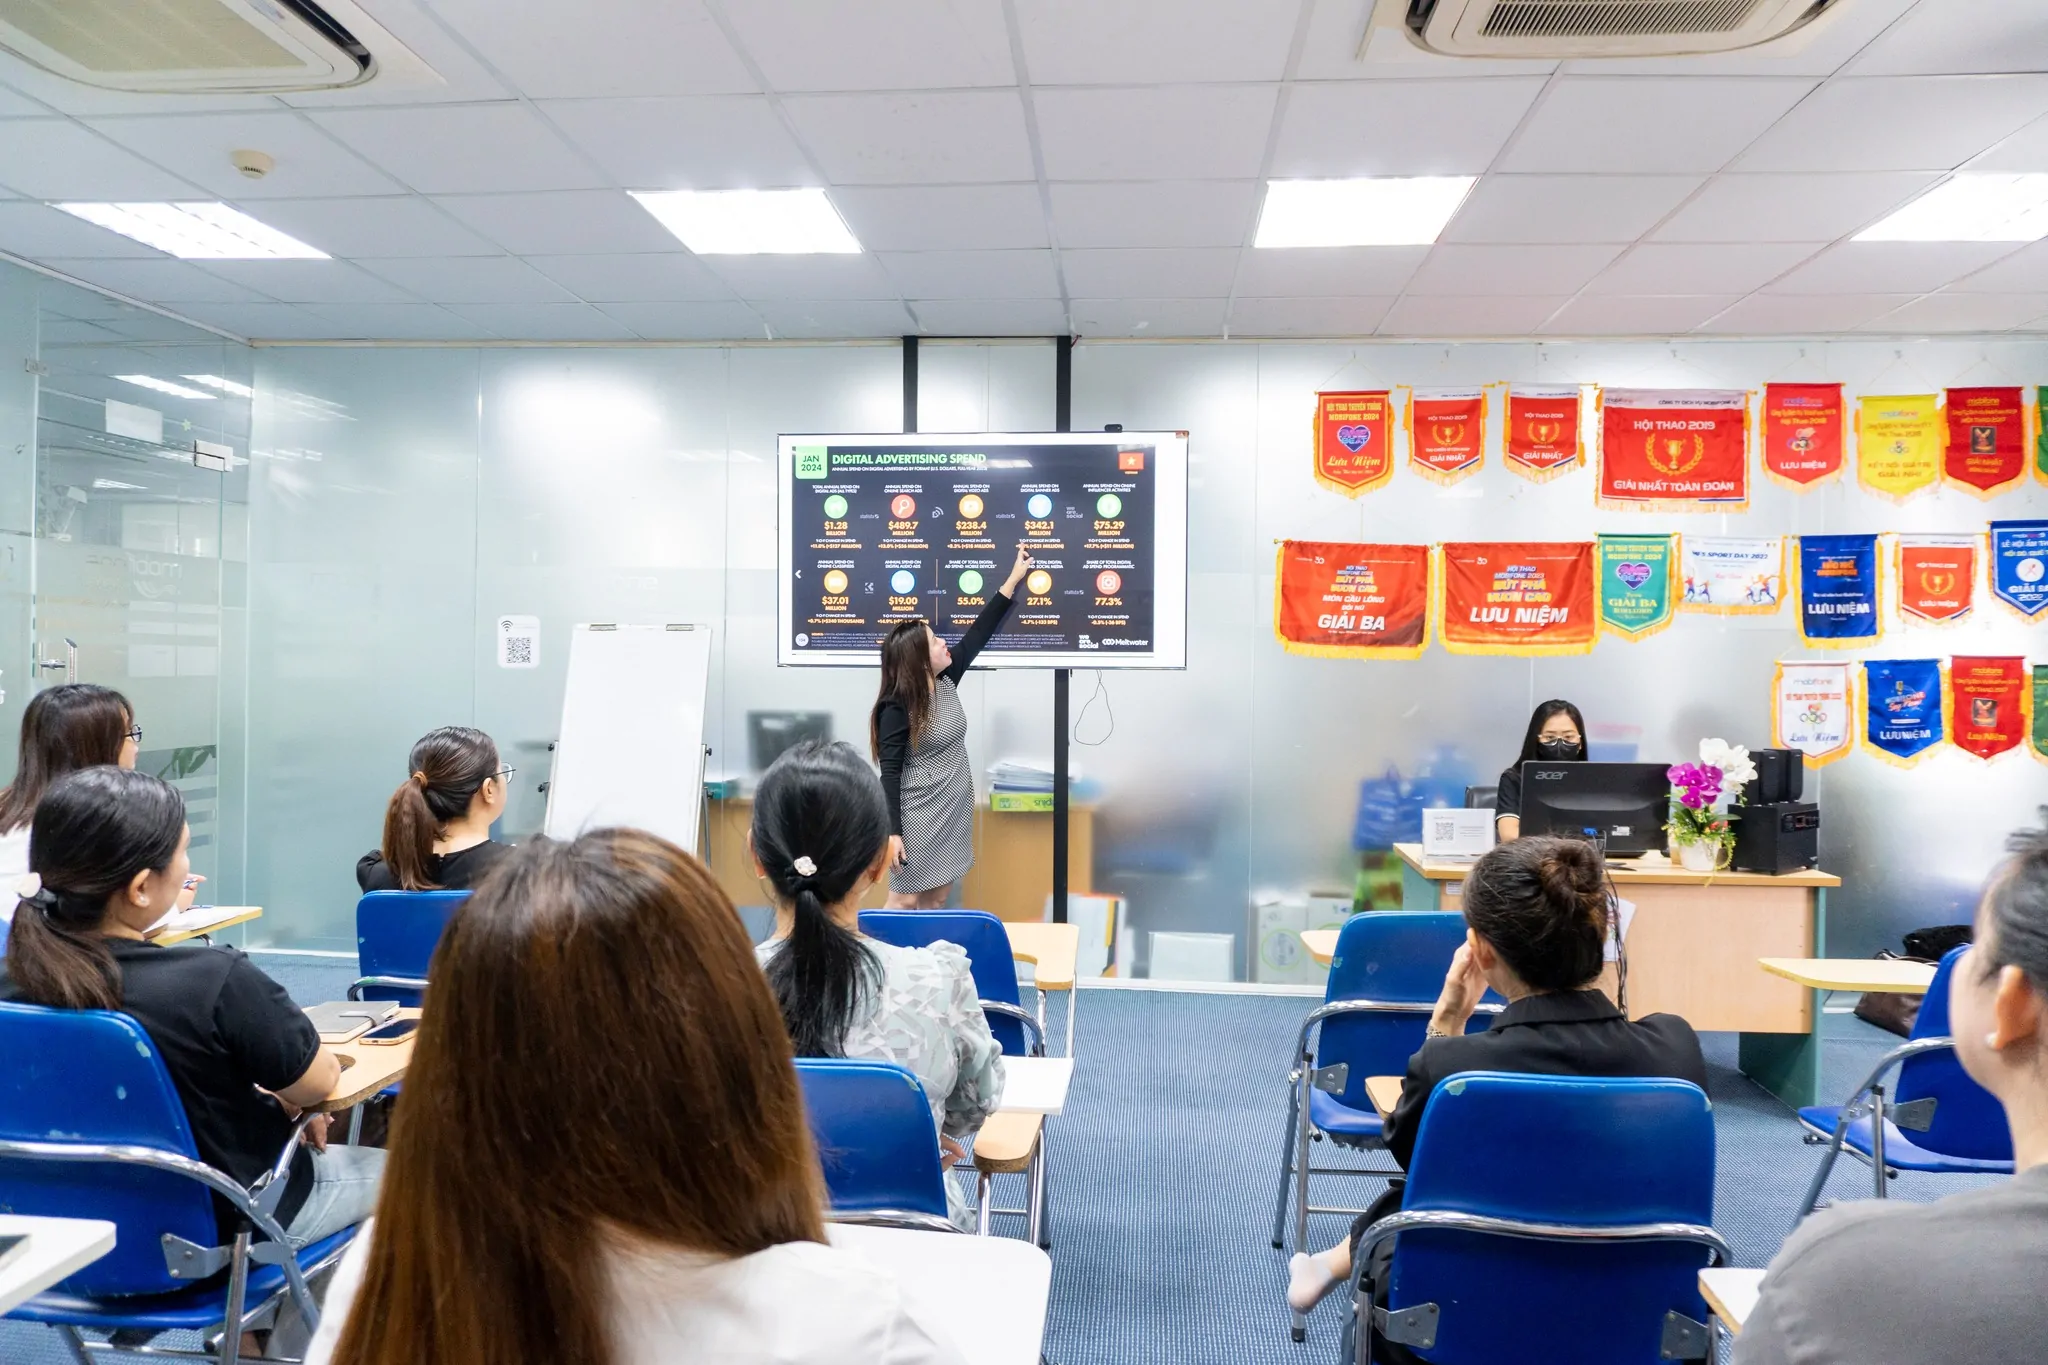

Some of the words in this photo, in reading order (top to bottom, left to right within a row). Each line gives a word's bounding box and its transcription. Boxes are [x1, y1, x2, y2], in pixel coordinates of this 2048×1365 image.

[1634, 419, 1653, 431] HỘI
[1656, 421, 1686, 430] THAO
[1688, 421, 1715, 430] 2019
[832, 454, 873, 464] DIGITAL
[875, 454, 947, 464] ADVERTISING
[950, 454, 986, 464] SPEND
[1430, 454, 1444, 462] GIẢI
[1523, 450, 1540, 459] GIẢI
[1542, 451, 1563, 459] NHẤT
[1327, 455, 1347, 466] Lưu
[1352, 455, 1380, 469] Niệm
[1614, 479, 1636, 490] GIẢI
[1638, 479, 1668, 491] NHẤT
[1670, 481, 1700, 492] TOÀN
[1703, 481, 1734, 491] ĐOÀN
[824, 521, 848, 530] $1.28
[888, 521, 918, 530] $489.7
[956, 520, 987, 530] $238.4
[1025, 520, 1054, 530] $342.1
[1094, 520, 1125, 530] $75.29
[2008, 583, 2035, 593] GIẢI
[822, 596, 849, 605] $37.01
[889, 596, 918, 605] $19.00
[957, 597, 985, 606] 55.0%
[1027, 597, 1052, 606] 27.1%
[1095, 597, 1122, 606] 77.3%
[1322, 594, 1342, 602] MÔN
[1344, 594, 1361, 603] CẦU
[1363, 595, 1385, 603] LÔNG
[1608, 597, 1635, 607] GIẢI
[1641, 599, 1657, 607] BA
[1808, 603, 1834, 614] LƯU
[1836, 601, 1870, 616] NIỆM
[1318, 611, 1355, 630] GIẢI
[1360, 616, 1385, 630] BA
[1470, 606, 1509, 623] LƯU
[1515, 605, 1569, 626] NIỆM
[1534, 771, 1568, 780] acer
